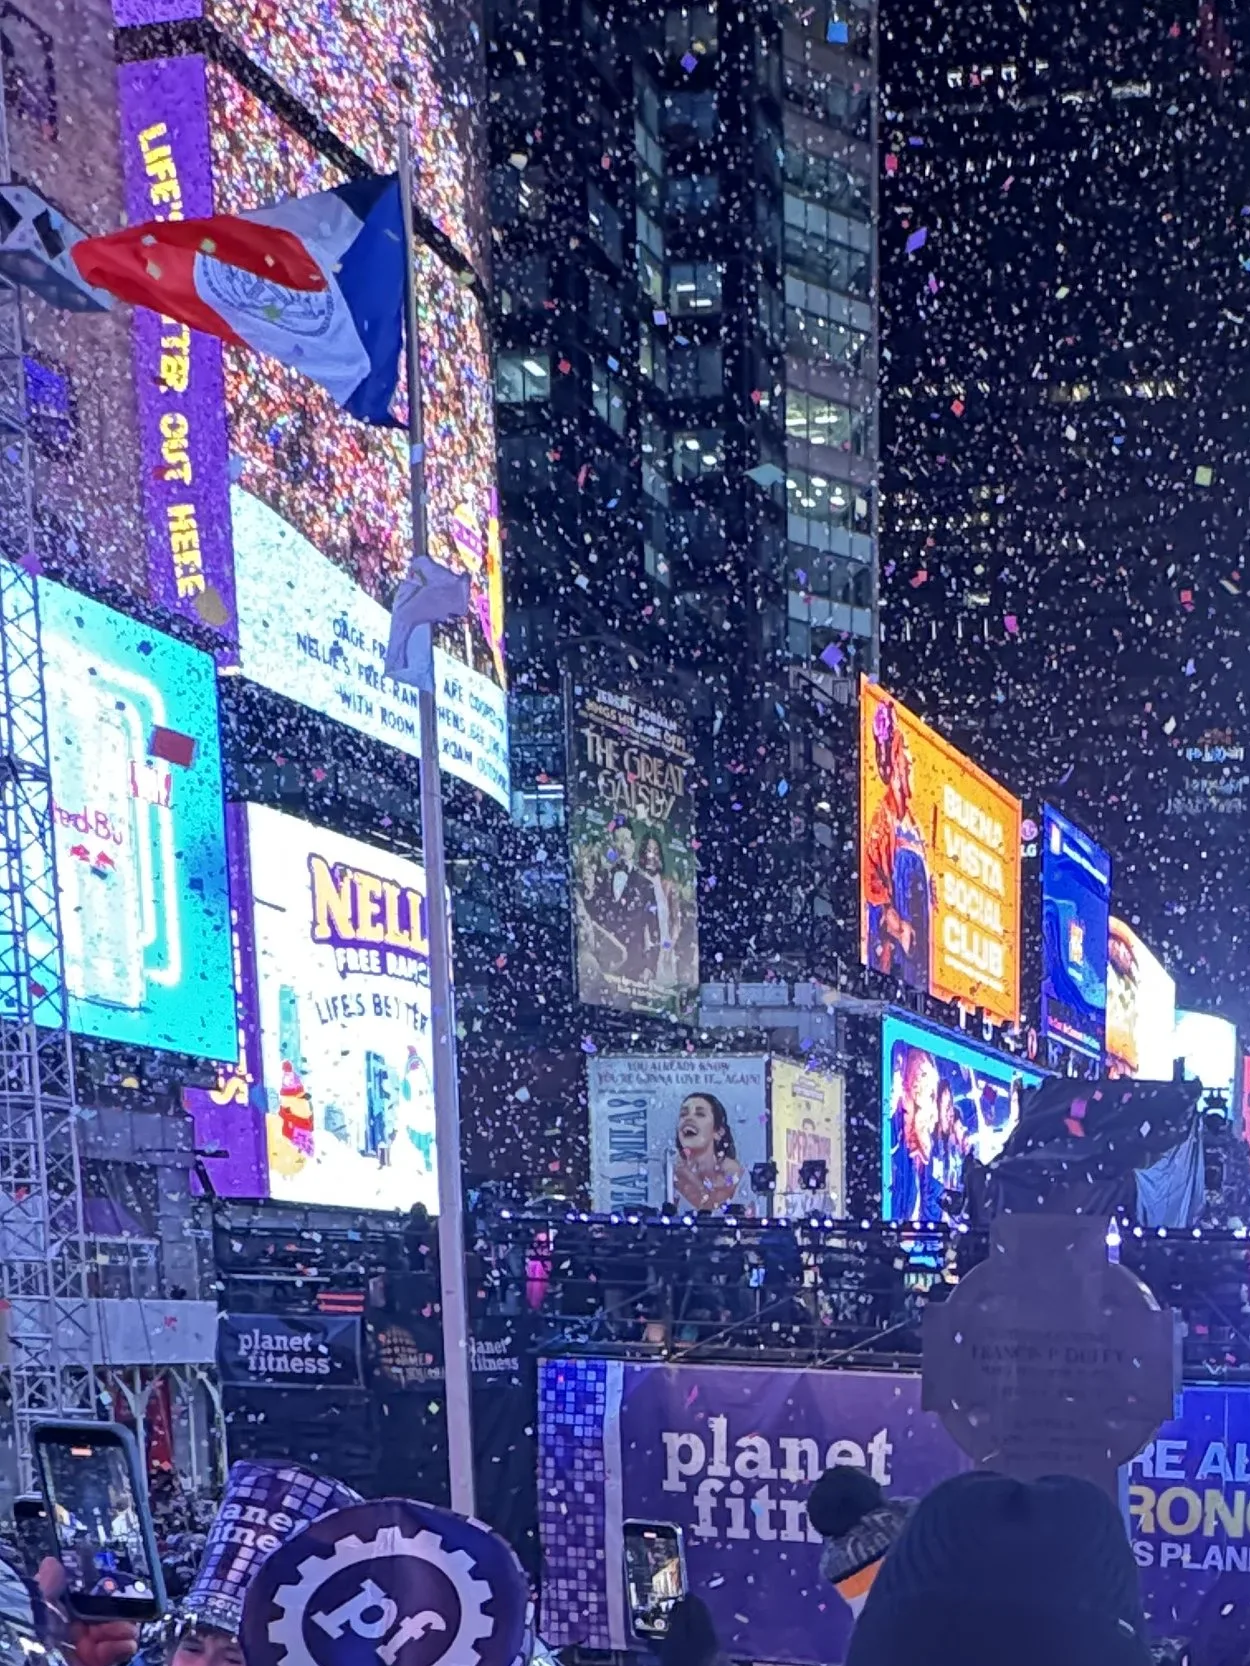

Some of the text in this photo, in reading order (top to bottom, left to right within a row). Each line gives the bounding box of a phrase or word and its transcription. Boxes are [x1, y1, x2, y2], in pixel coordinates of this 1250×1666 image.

[166, 503, 206, 599] HERE
[357, 659, 419, 708] FREE-RAN
[380, 705, 416, 735] ROOM
[580, 724, 687, 797] THE GREAT
[943, 784, 1005, 853] BUENA
[943, 822, 1005, 898] VISTA
[943, 914, 1005, 979] CLUB
[315, 993, 366, 1025] LIFE'S
[237, 1328, 313, 1355] planet
[247, 1350, 331, 1375] fitness
[661, 1414, 893, 1493] planet
